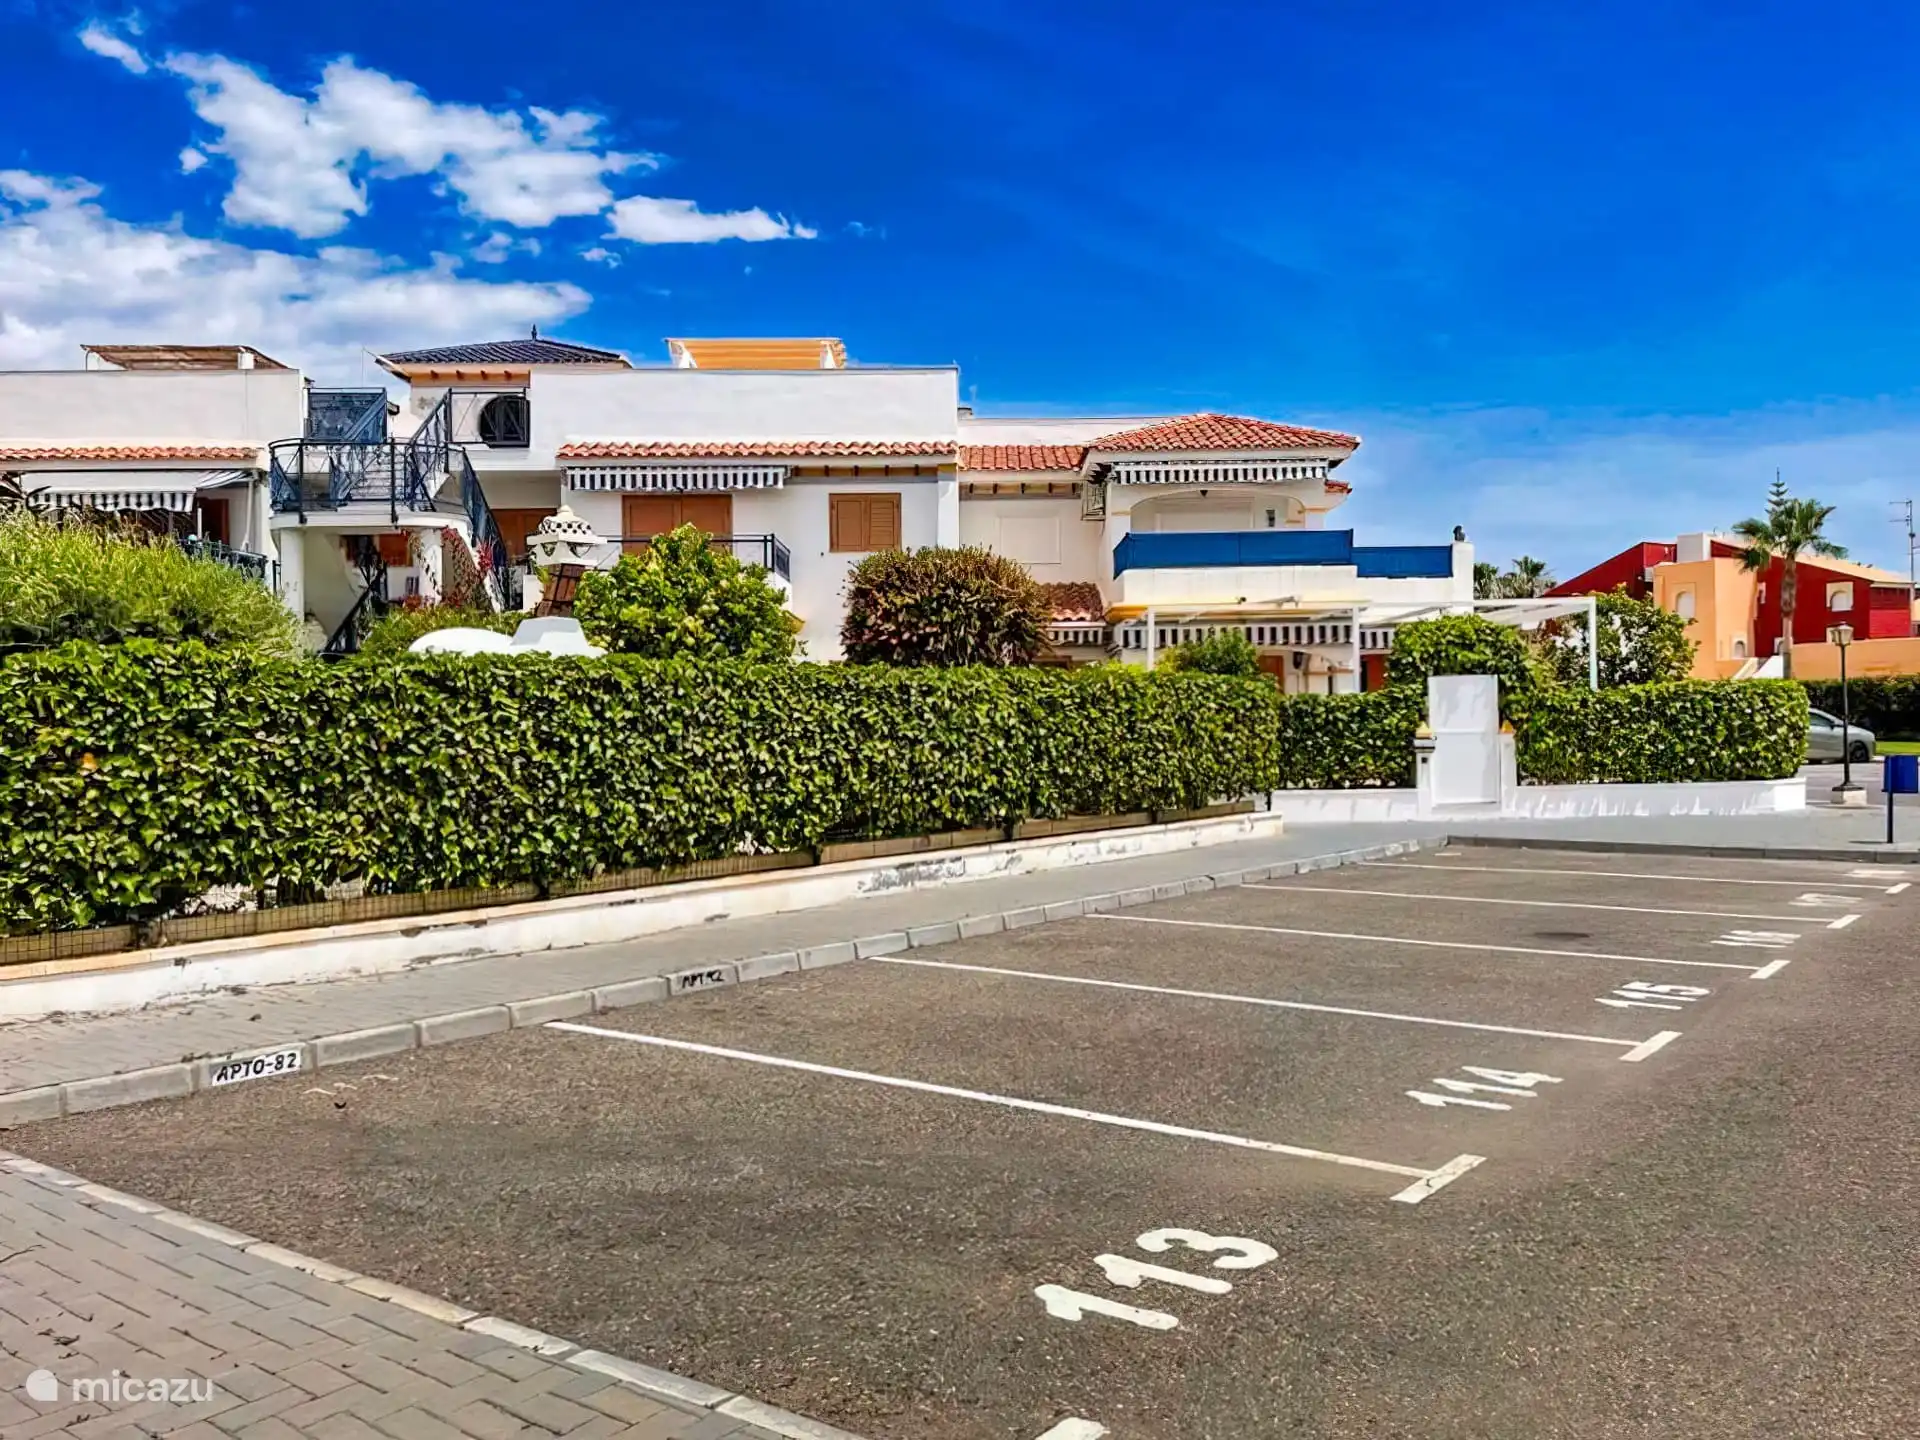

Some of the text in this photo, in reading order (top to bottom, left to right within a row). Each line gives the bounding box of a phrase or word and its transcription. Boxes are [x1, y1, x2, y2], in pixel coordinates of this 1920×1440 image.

[1594, 980, 1710, 1011] 115
[216, 1052, 297, 1082] APTO-82
[1405, 1065, 1564, 1111] 114
[1034, 1227, 1279, 1331] 113
